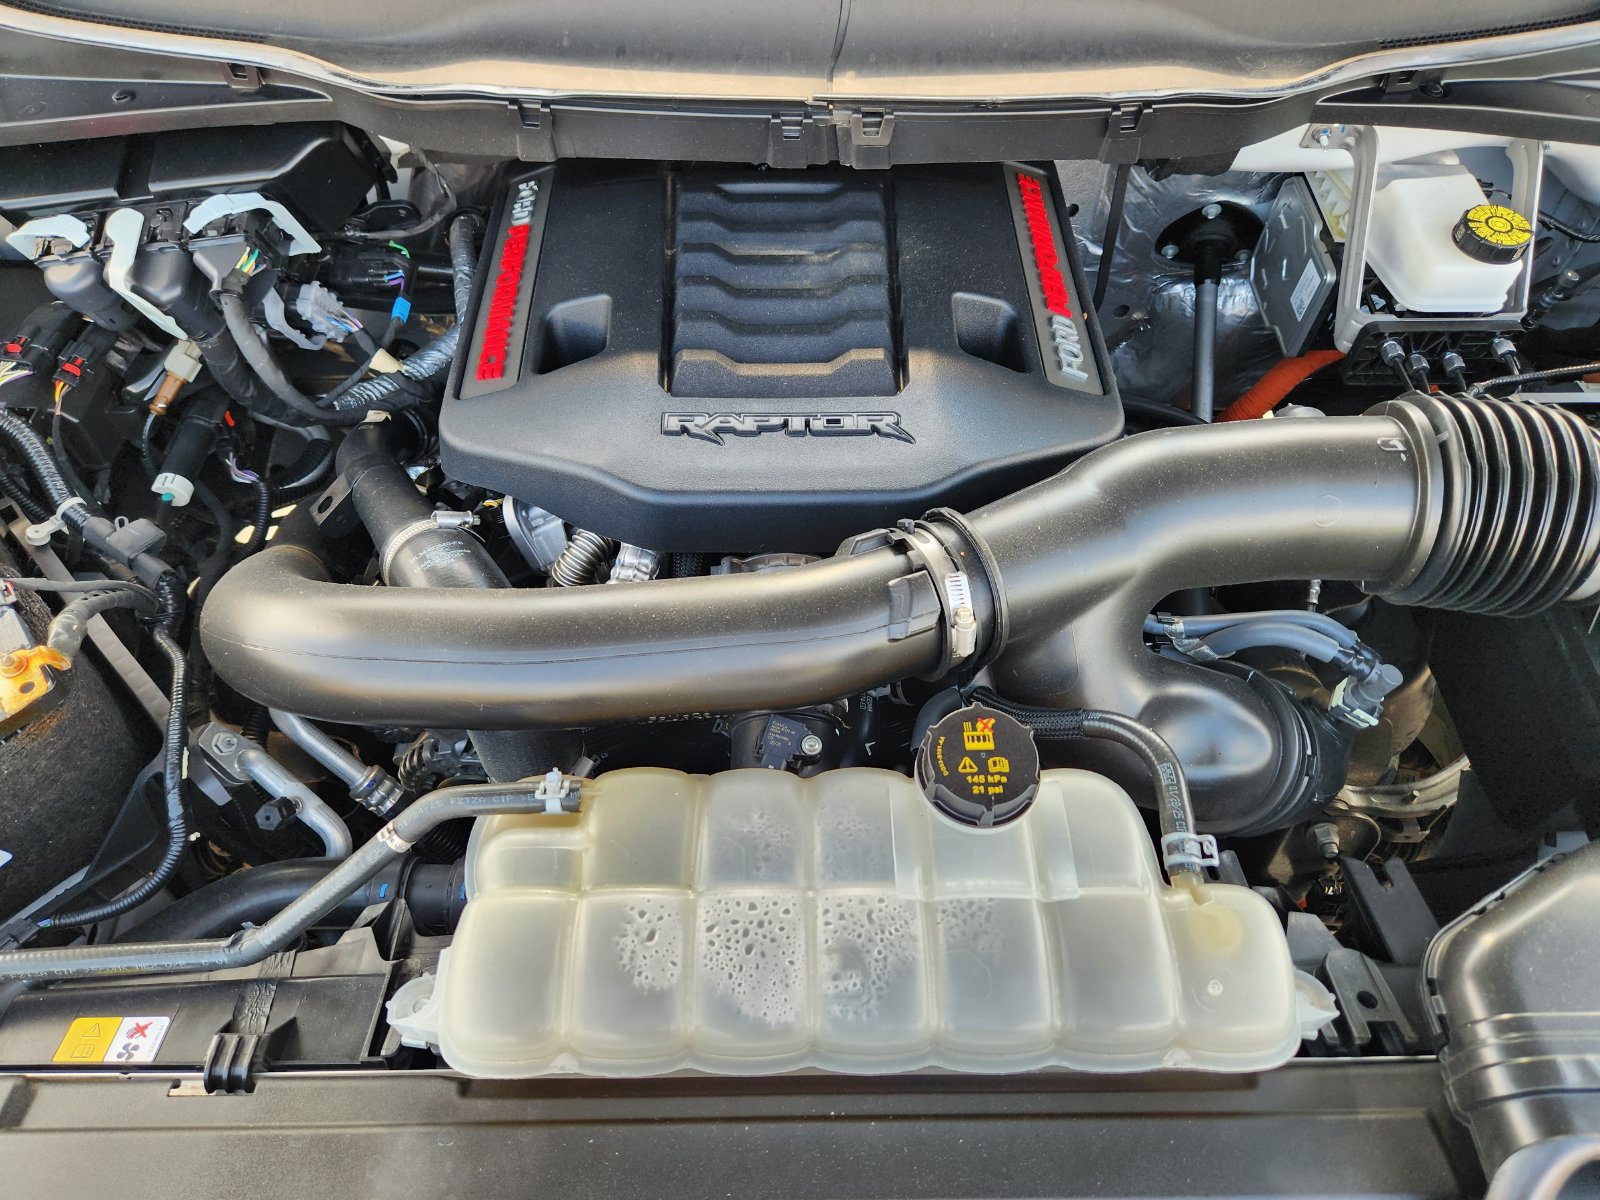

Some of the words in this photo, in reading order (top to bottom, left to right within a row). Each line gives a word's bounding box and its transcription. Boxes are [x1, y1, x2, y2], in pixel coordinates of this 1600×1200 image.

[1018, 173, 1072, 318] PERFORMANCE
[476, 224, 531, 380] PERFORMANCE
[1051, 314, 1088, 380] FORD
[661, 411, 916, 446] RAPTOR
[966, 774, 986, 784] 145
[988, 774, 1007, 784] kPa
[972, 785, 985, 795] 21
[988, 785, 1003, 796] psi
